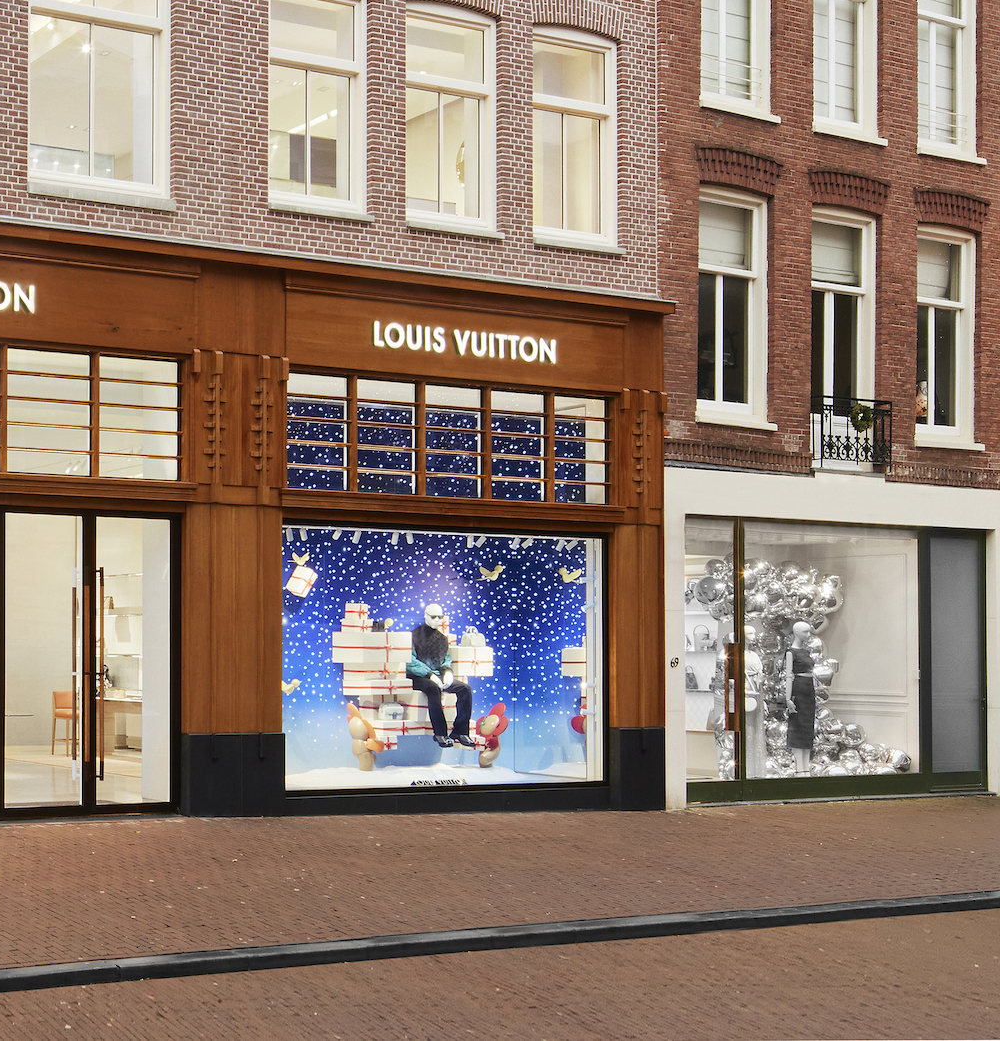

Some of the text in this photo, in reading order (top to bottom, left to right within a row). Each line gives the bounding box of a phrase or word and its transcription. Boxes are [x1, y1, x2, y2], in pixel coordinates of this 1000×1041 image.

[373, 320, 557, 365] LOUIS VUITTON
[670, 657, 680, 669] 69
